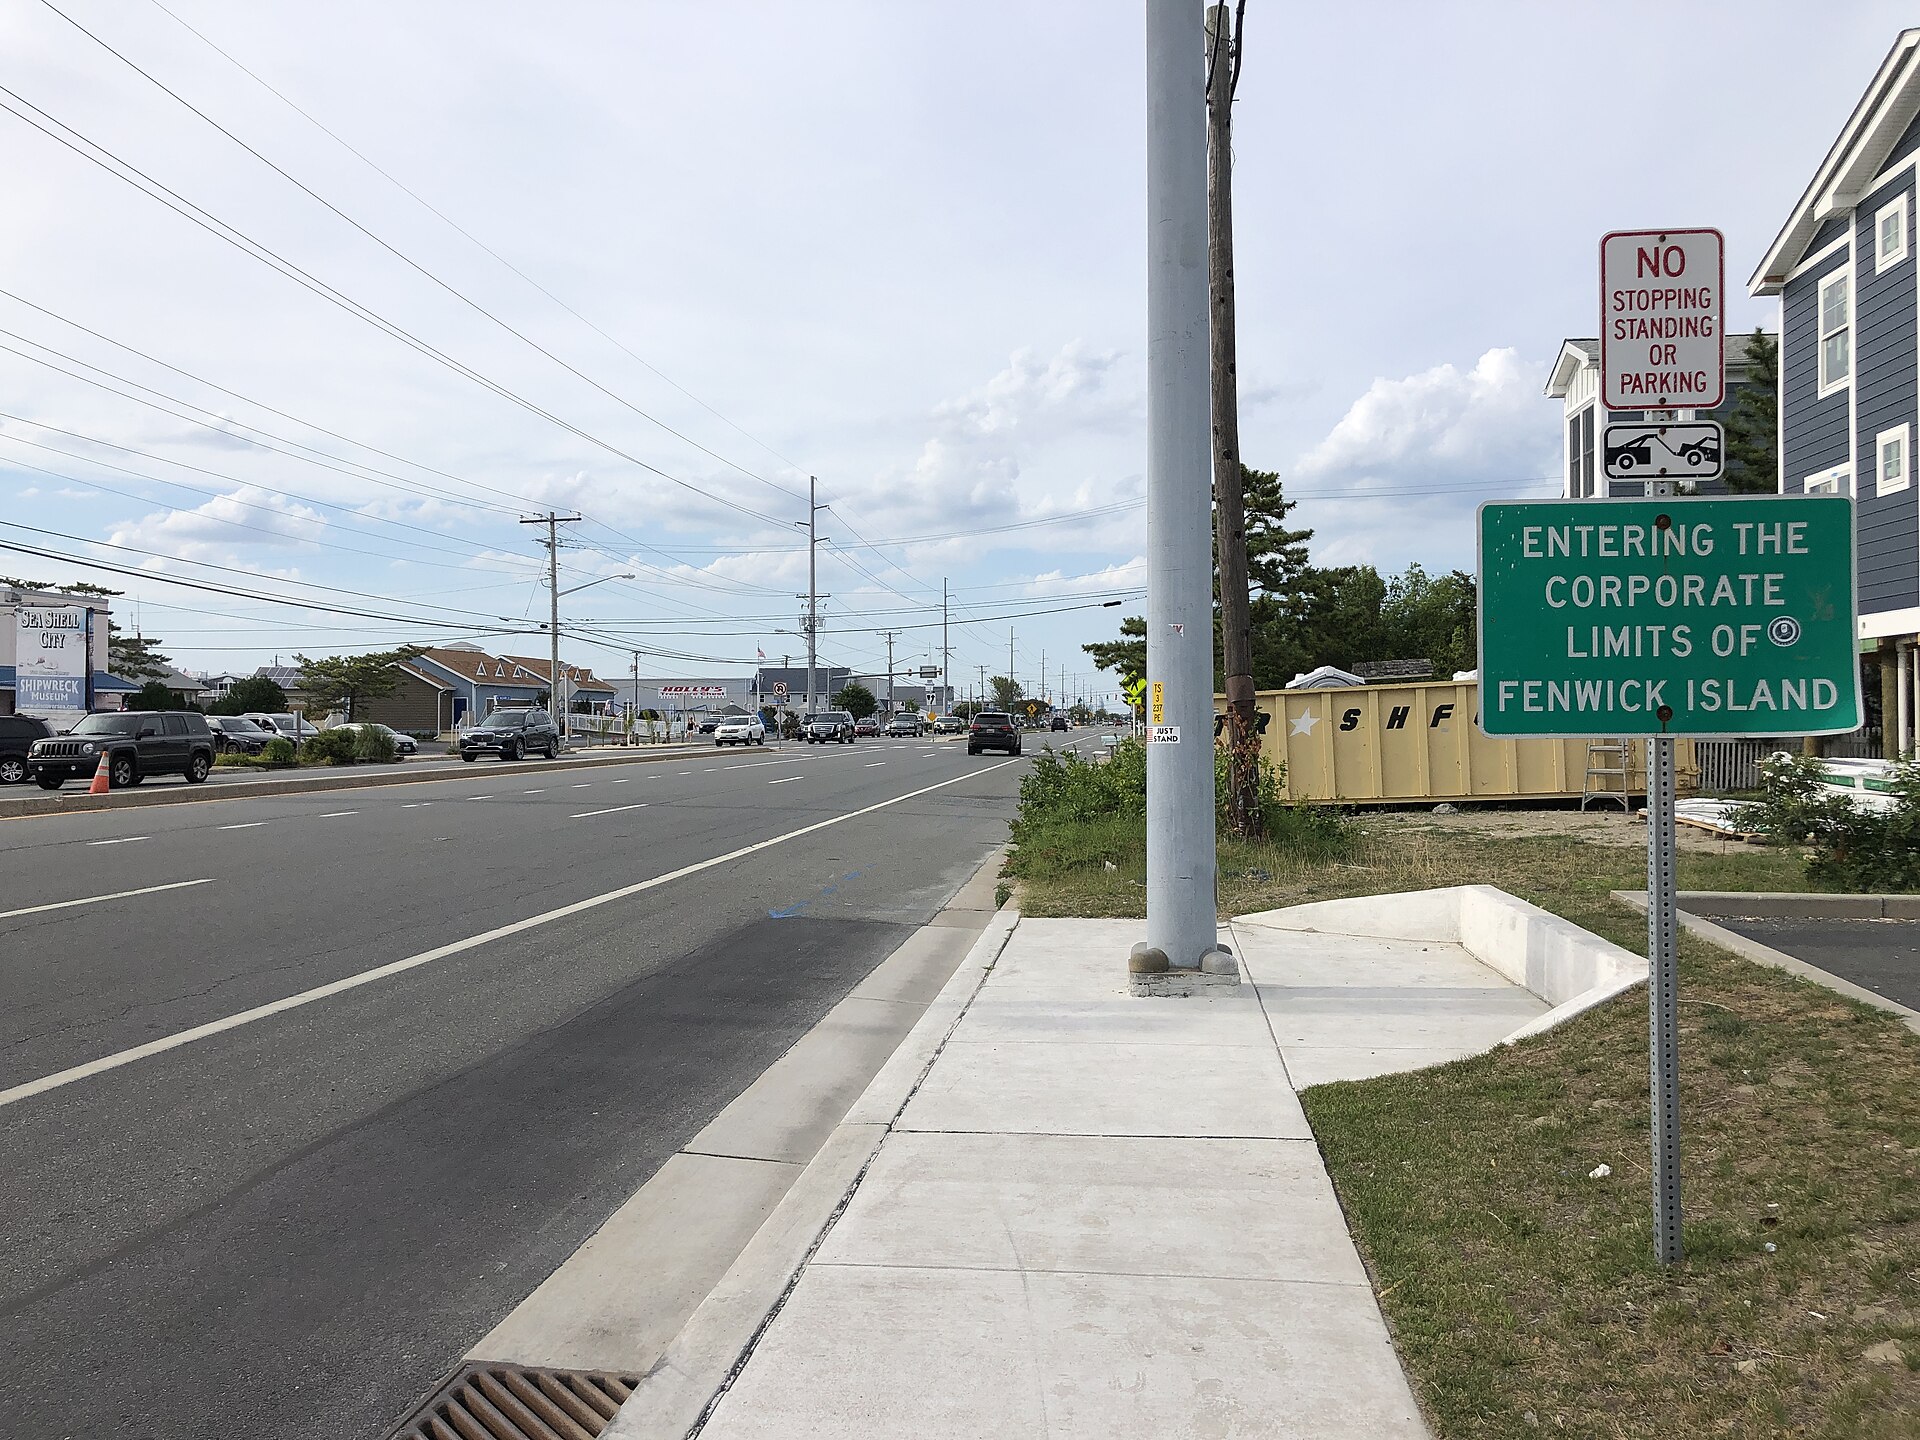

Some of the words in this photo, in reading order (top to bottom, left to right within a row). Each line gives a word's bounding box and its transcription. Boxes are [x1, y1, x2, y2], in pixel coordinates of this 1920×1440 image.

[1637, 245, 1686, 279] NO
[1612, 287, 1712, 312] STOPPING
[1613, 315, 1714, 340] STANDING
[1649, 344, 1677, 366] OR
[1620, 371, 1707, 396] PARKING
[1522, 522, 1715, 558] ENTERING
[1732, 521, 1810, 556] THE
[1545, 573, 1786, 609] CORPORATE
[21, 610, 43, 628] SEA
[45, 611, 80, 629] SHELL
[39, 631, 66, 649] CITY
[1567, 624, 1693, 659] LIMITS
[1712, 624, 1763, 657] OF
[20, 679, 79, 694] SHIPWRECK
[1154, 684, 1162, 693] TS
[1498, 680, 1667, 713] FENWICK
[1686, 678, 1838, 712] ISLAND
[31, 692, 69, 701] MUSEUM
[1155, 694, 1160, 703] 3
[1152, 704, 1163, 712] 237
[1154, 714, 1161, 722] PE
[1153, 735, 1178, 743] STAND
[1157, 727, 1174, 735] JUST
